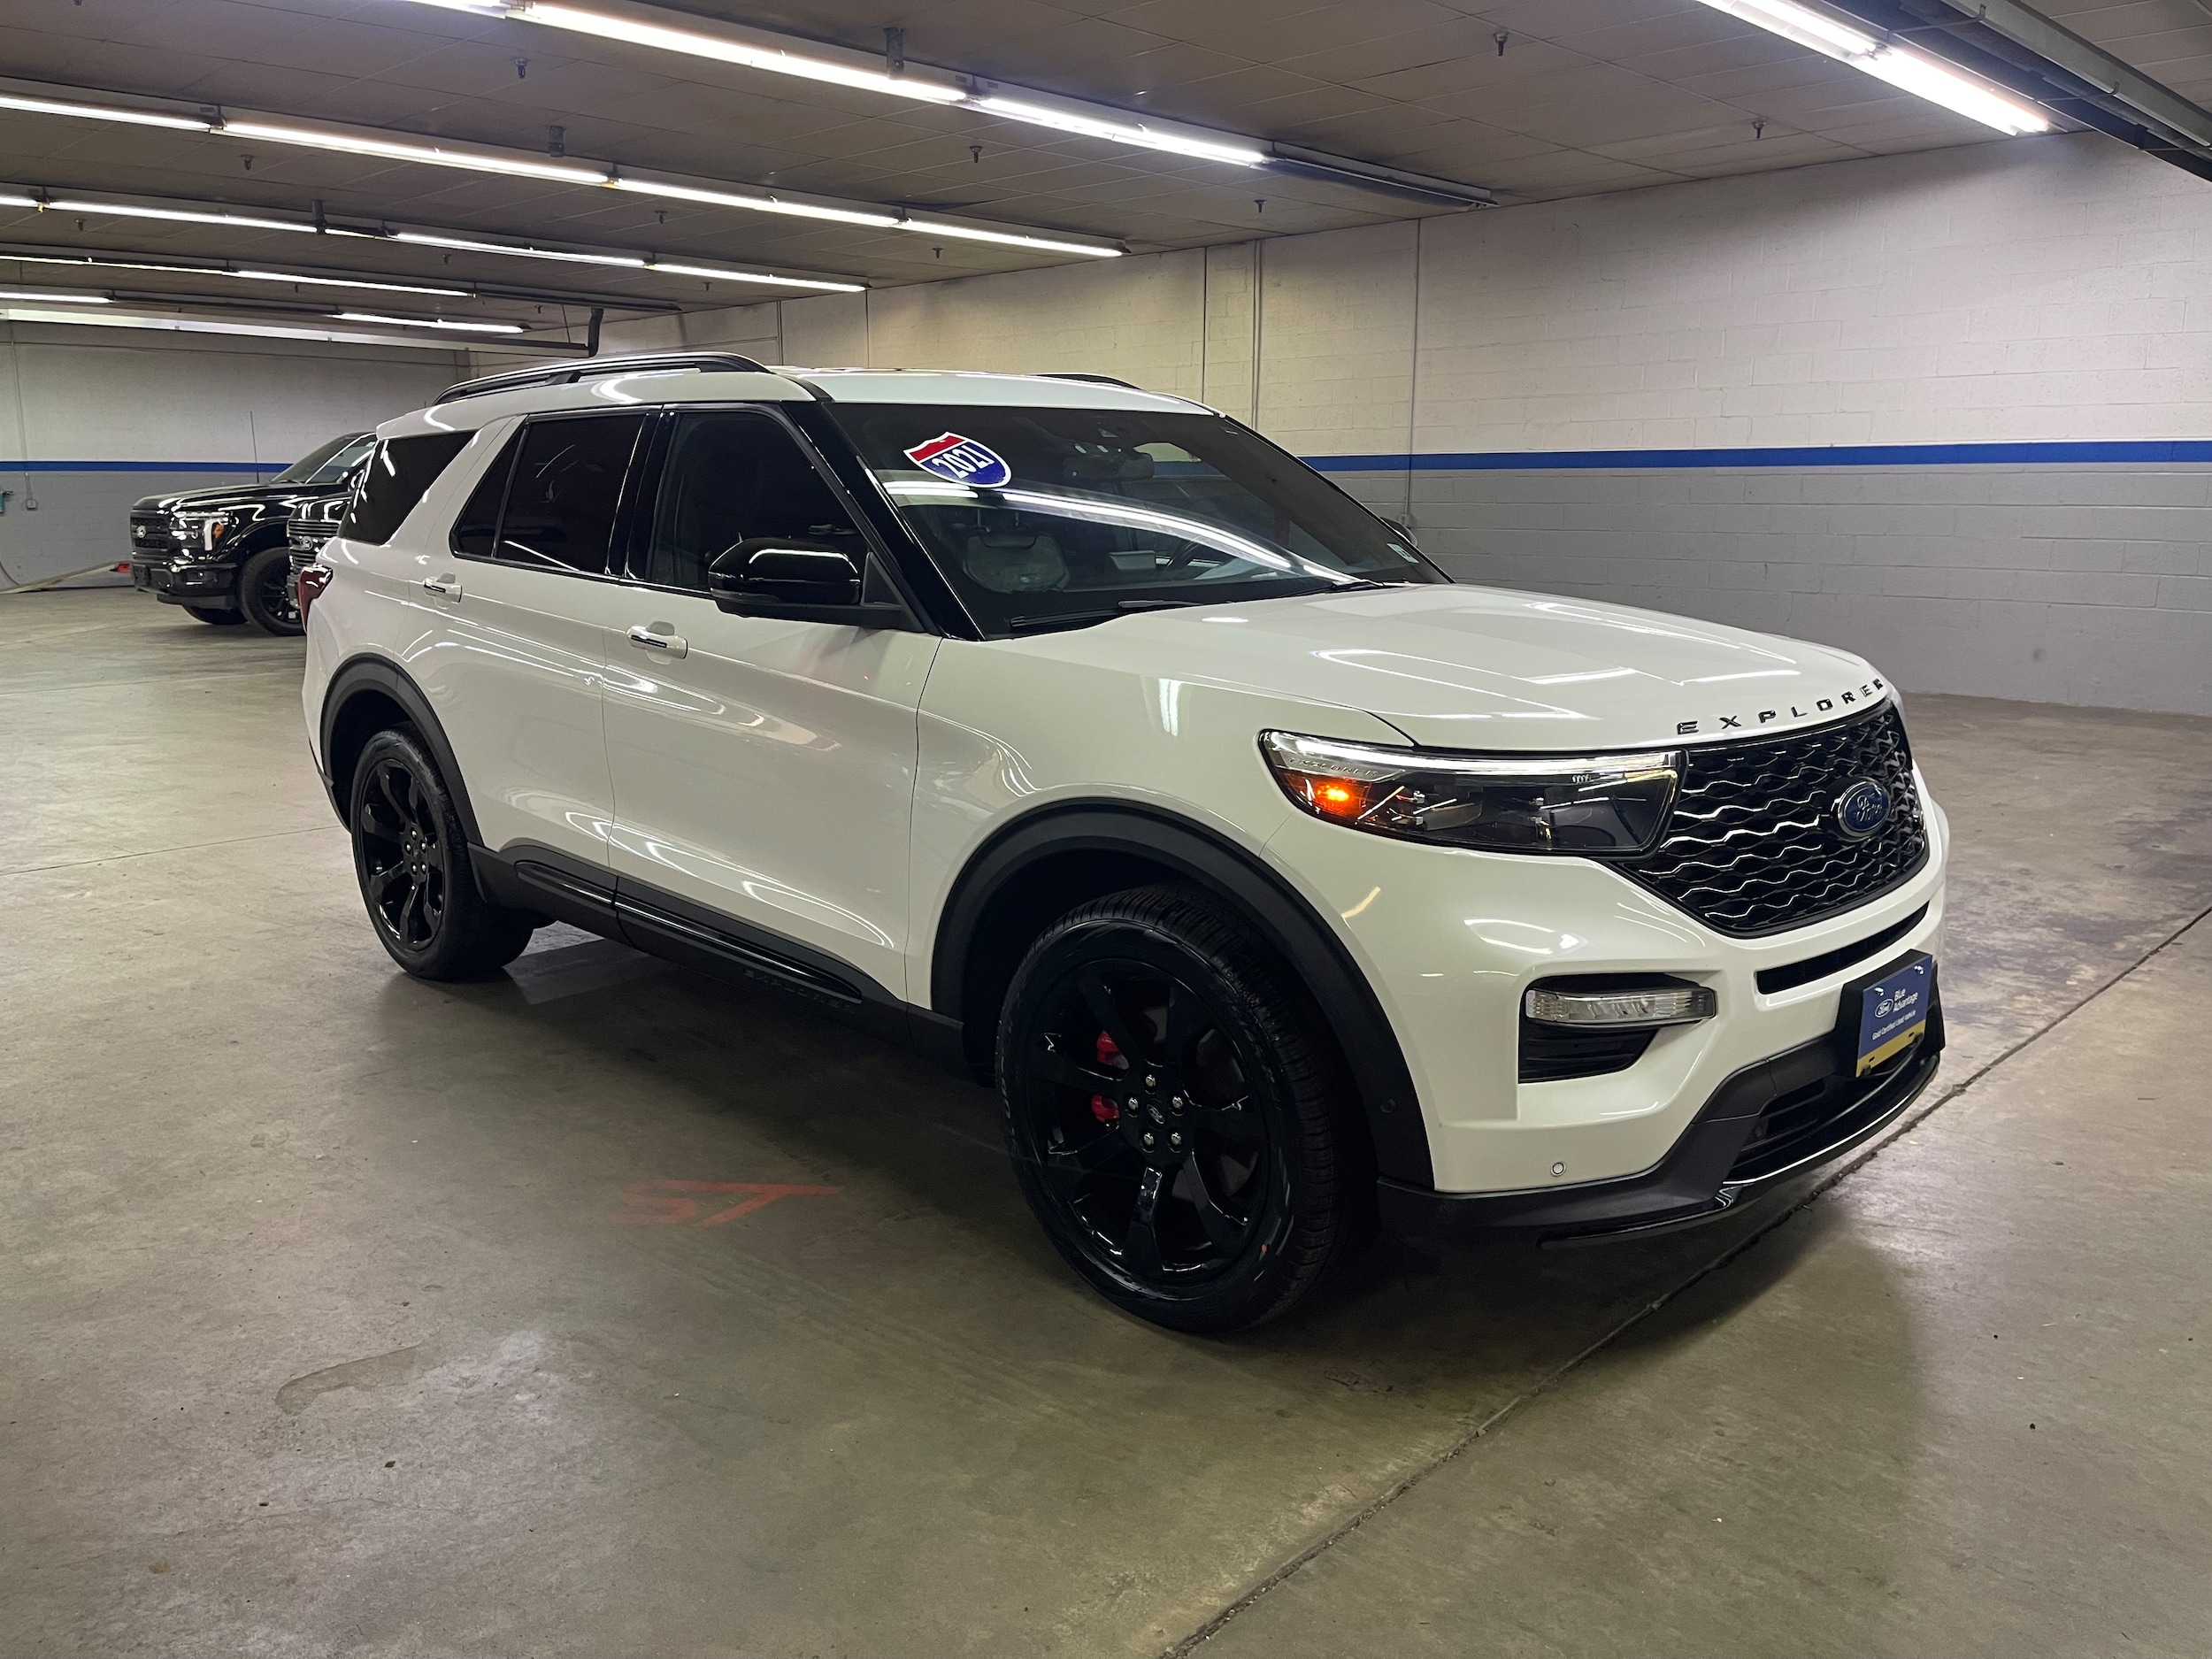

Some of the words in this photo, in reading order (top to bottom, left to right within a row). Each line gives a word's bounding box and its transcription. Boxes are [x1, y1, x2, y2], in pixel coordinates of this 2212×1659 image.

[932, 444, 995, 479] 2021
[1676, 678, 1884, 735] EXPLORER
[1893, 992, 1918, 1012] Advantage
[1894, 988, 1906, 1001] Blue
